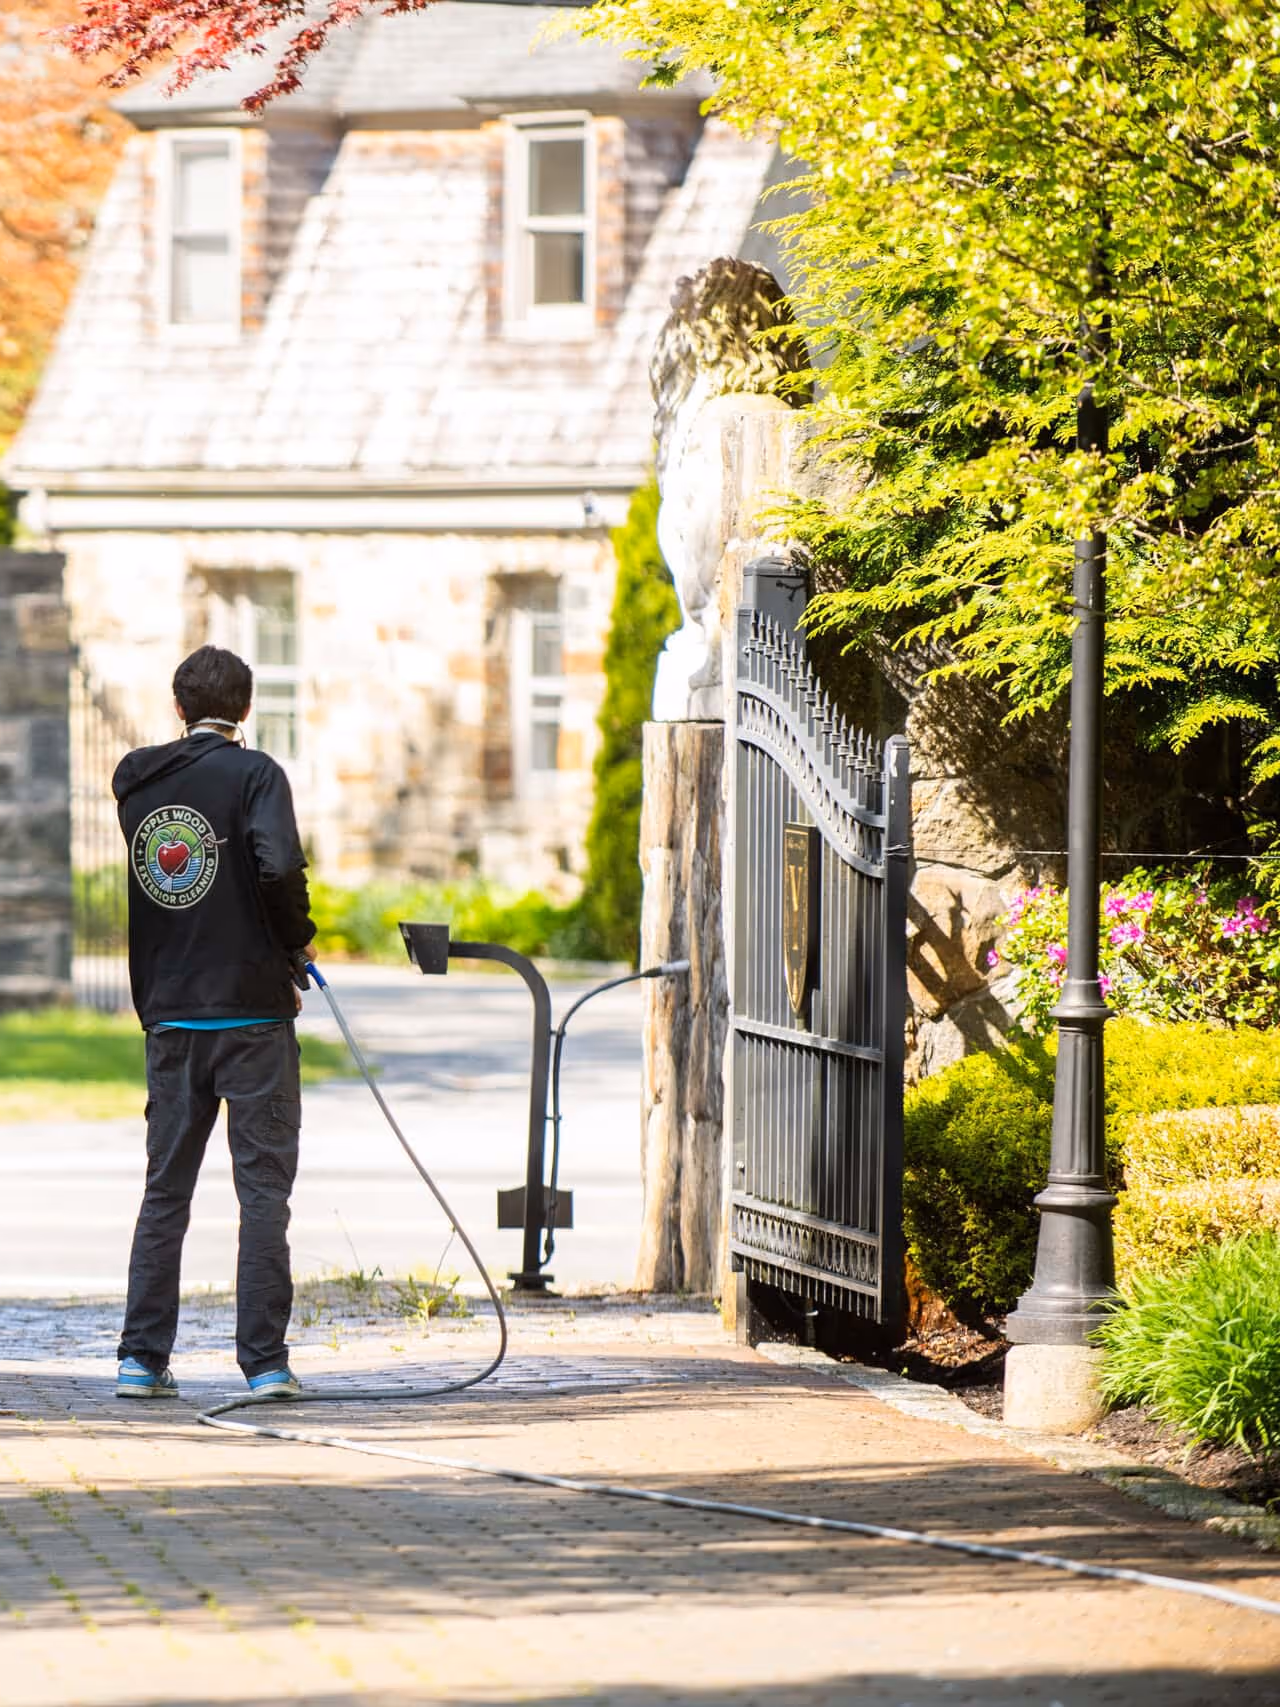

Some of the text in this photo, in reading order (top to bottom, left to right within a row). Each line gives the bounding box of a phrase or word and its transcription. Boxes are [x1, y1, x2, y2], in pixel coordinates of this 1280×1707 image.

[140, 809, 206, 842] APPLE WOOD
[137, 857, 215, 904] EXTERIOR CLEANING
